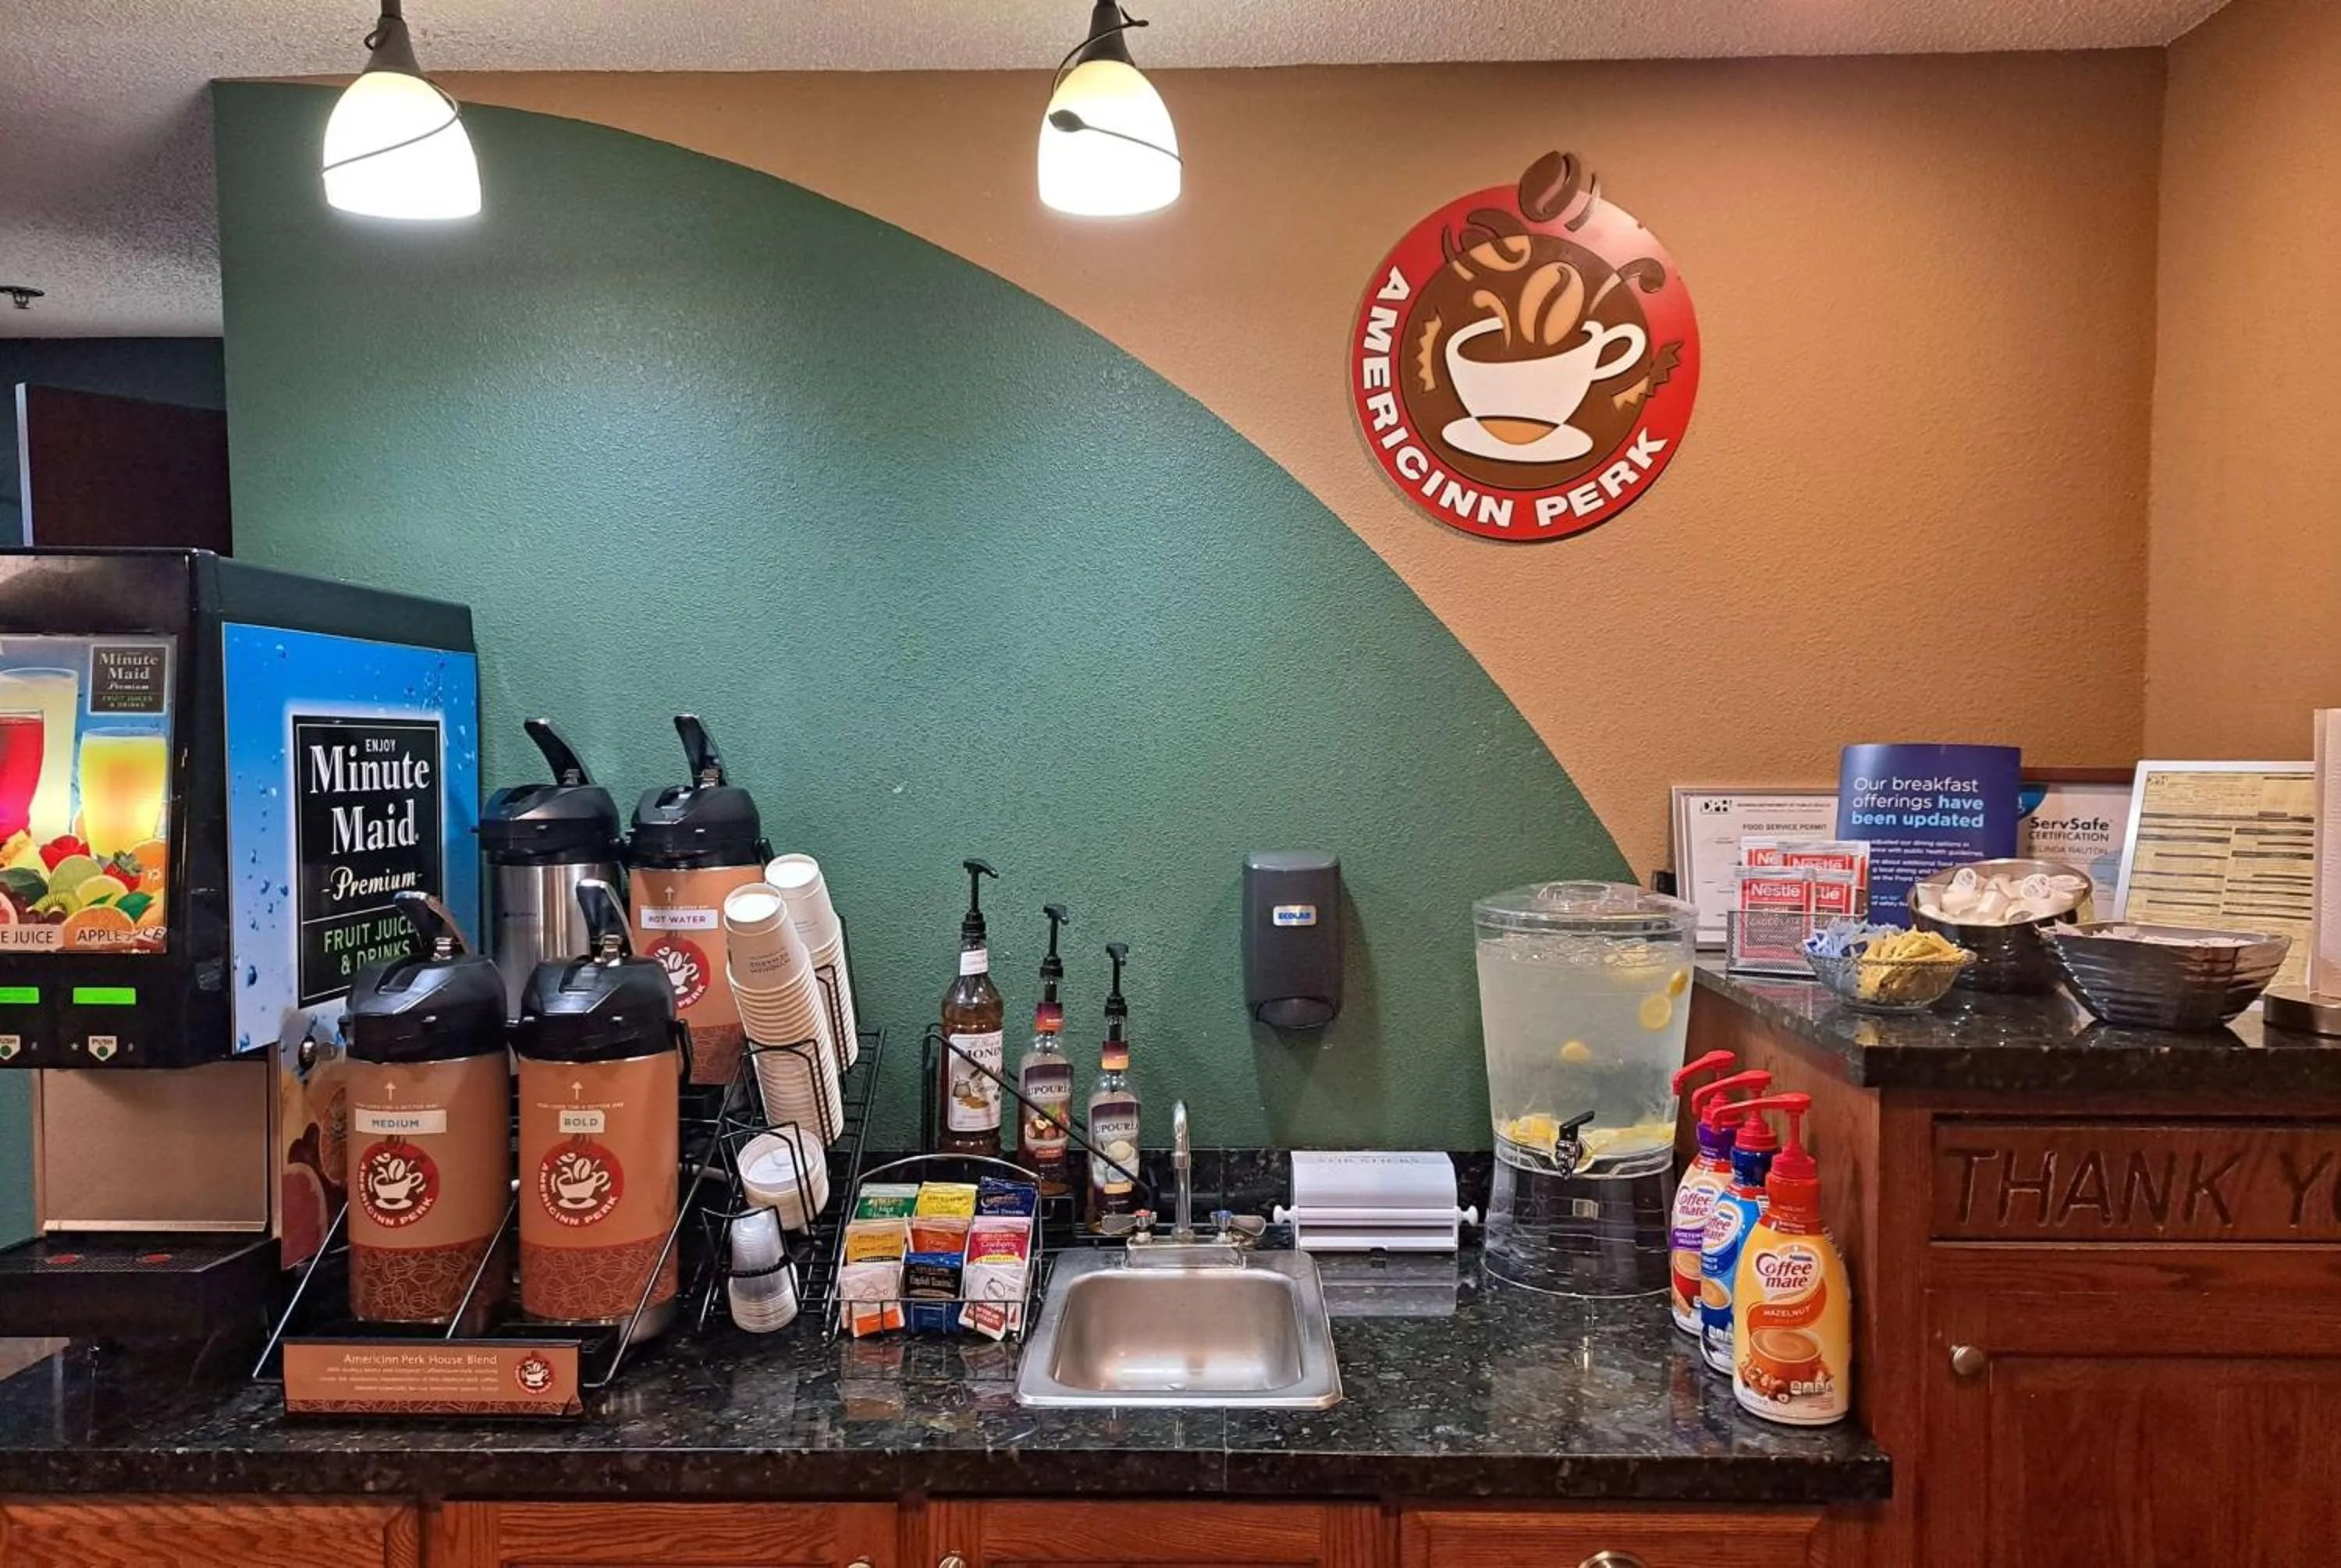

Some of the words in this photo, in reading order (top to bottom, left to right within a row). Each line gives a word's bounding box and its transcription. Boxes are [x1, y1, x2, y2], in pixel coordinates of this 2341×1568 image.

[1362, 267, 1514, 527] AMERICINN
[1535, 428, 1668, 527] PERK
[99, 653, 159, 665] Minute
[108, 668, 150, 679] Maid
[366, 739, 396, 753] ENJOY
[310, 746, 430, 793] Minute
[1853, 777, 1887, 791] Our
[1892, 776, 1979, 793] breakfast
[1853, 794, 1933, 811] offerings
[1938, 795, 1984, 810] have
[331, 799, 416, 854] Maid
[1852, 811, 1896, 825] been
[1902, 812, 1984, 828] updated
[2030, 817, 2109, 831] ServSafe
[2029, 831, 2109, 842] CERTIFICATION
[330, 867, 416, 900] Premium
[669, 915, 706, 924] WATER
[12, 931, 54, 945] JUICE
[77, 929, 122, 942] APPLE
[324, 923, 370, 953] FRUIT
[340, 956, 350, 975] &
[677, 984, 706, 1009] PERK
[371, 1119, 420, 1128] MEDIUM
[564, 1118, 599, 1126] BOLD
[360, 1162, 394, 1226] AMERICINN
[400, 1196, 433, 1224] PERK
[539, 1162, 580, 1226] AMERICINN
[584, 1195, 618, 1224] PERK
[1678, 1186, 1712, 1205] Coffee
[1943, 1148, 2244, 1229] THANK
[2279, 1150, 2341, 1229] Y
[1678, 1204, 1709, 1216] mate
[1756, 1252, 1813, 1276] Coffee
[1765, 1274, 1808, 1288] mate
[1764, 1305, 1811, 1318] HAZELNUT
[401, 1353, 425, 1364] Perk
[429, 1354, 463, 1364] House
[467, 1354, 498, 1364] Blend
